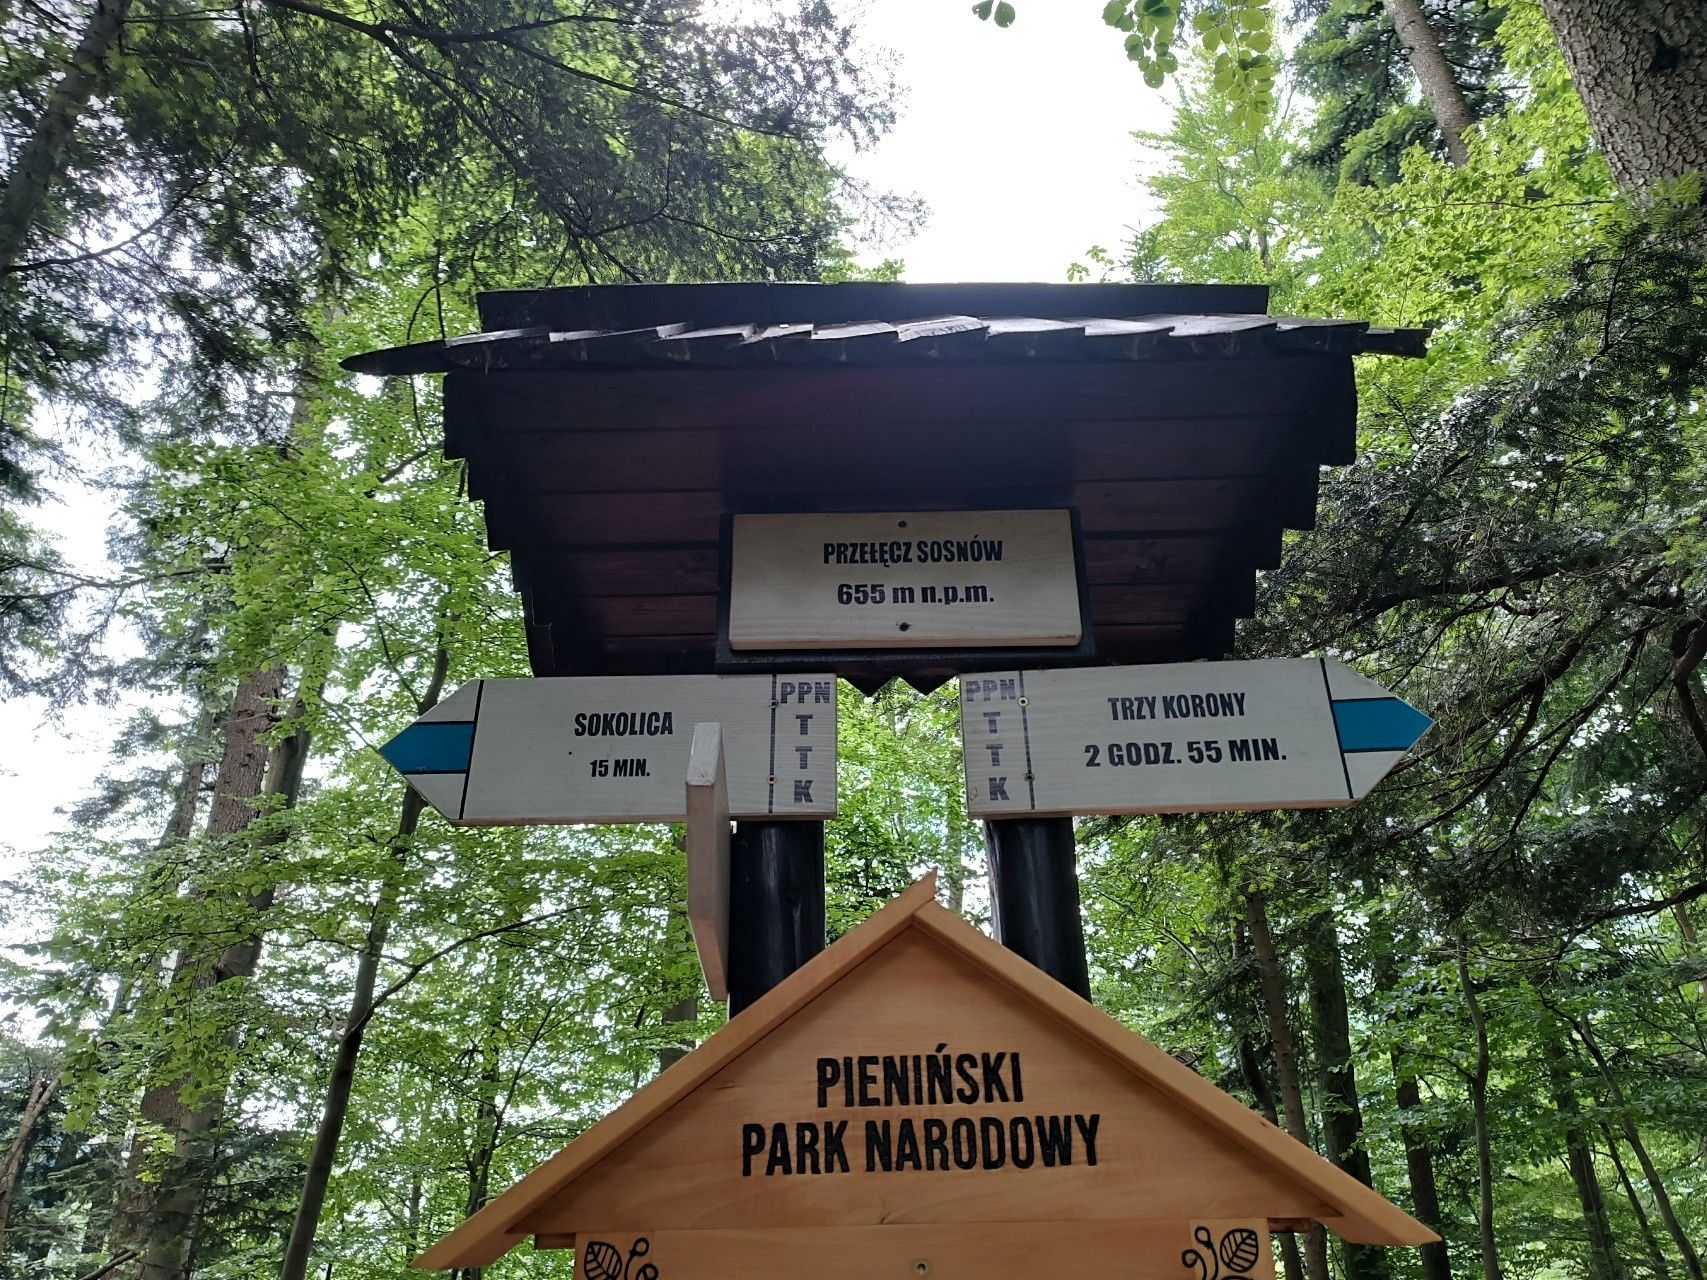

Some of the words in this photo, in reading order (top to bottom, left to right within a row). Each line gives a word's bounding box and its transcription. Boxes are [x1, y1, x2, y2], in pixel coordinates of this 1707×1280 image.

[823, 541, 913, 568] PRZEŁĘCZ
[916, 535, 1003, 563] SOSNÓW
[836, 583, 886, 606] 655
[892, 585, 915, 604] m
[920, 584, 995, 606] n.p.m.
[780, 681, 831, 704] PPN
[965, 679, 1016, 702] PPN
[1107, 696, 1157, 721] TRZY
[1161, 692, 1246, 720] KORONY
[573, 711, 674, 737] SOKOLICA
[1084, 744, 1101, 768] 2
[1107, 741, 1182, 767] GODZ.
[1186, 740, 1223, 765] 55
[1227, 737, 1287, 763] MIN.
[589, 759, 610, 778] 15
[612, 758, 651, 778] MIN.
[816, 1043, 1025, 1109] PIENIŃSKI
[742, 1119, 850, 1178] PARK
[864, 1113, 1101, 1173] NARODOWY
